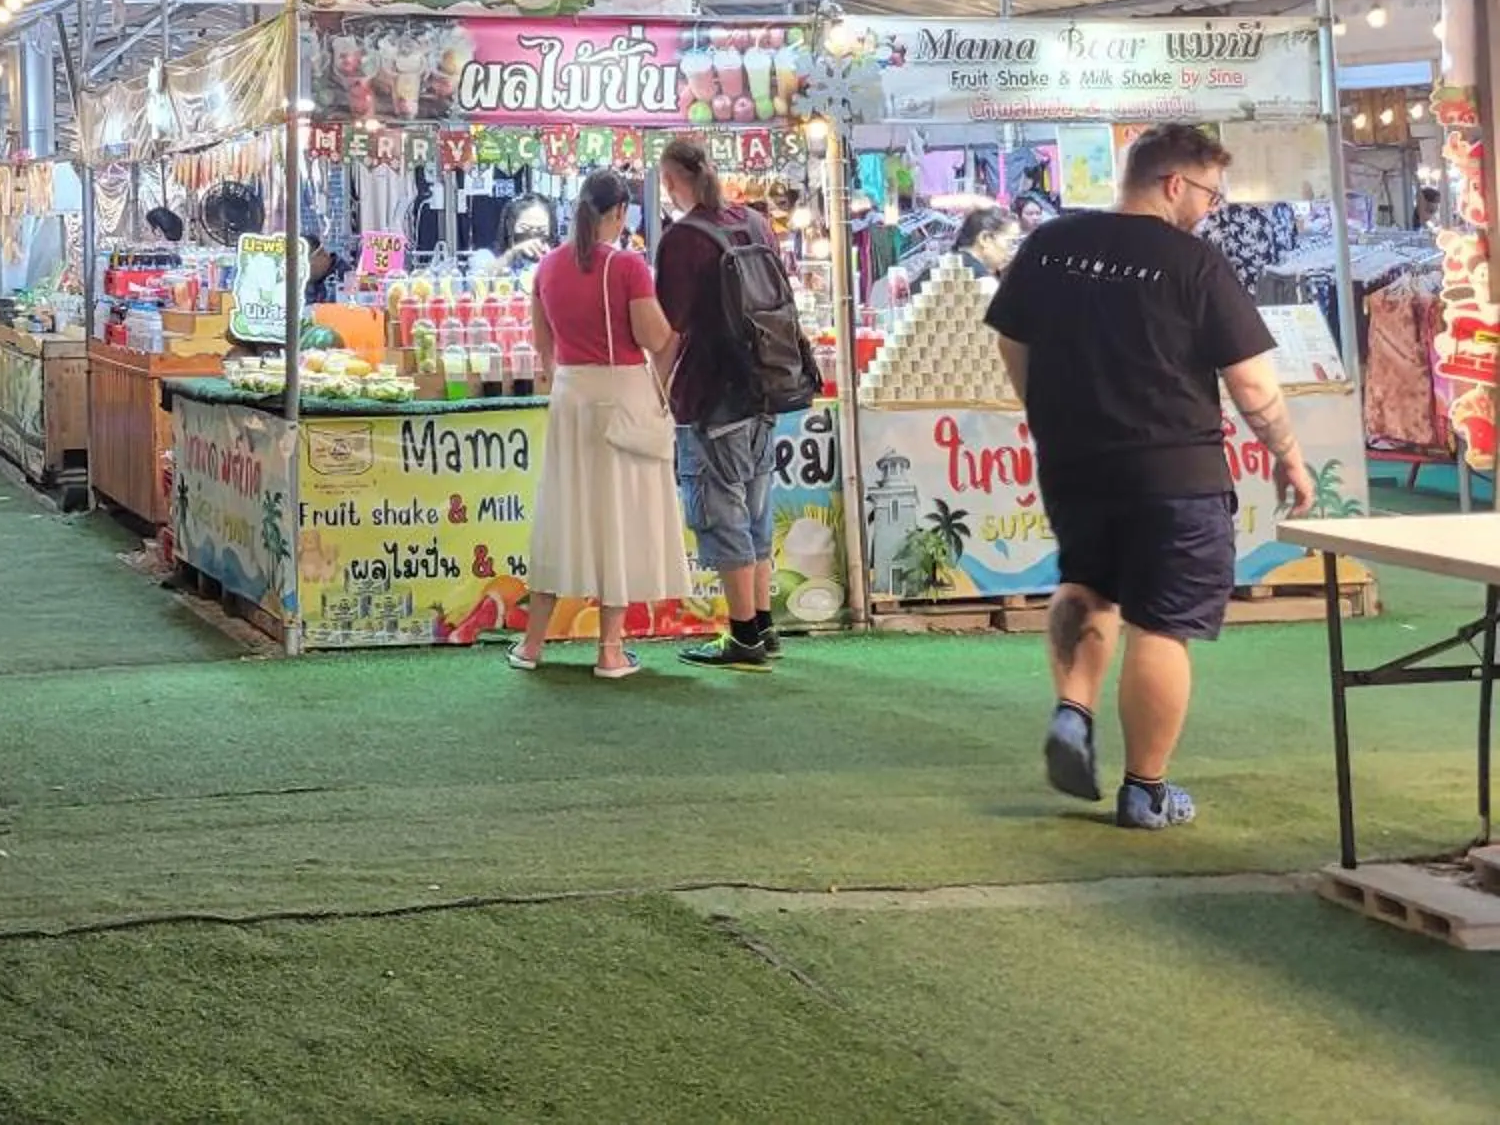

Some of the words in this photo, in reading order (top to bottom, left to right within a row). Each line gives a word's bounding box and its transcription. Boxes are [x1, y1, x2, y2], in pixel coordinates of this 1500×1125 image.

[916, 27, 1038, 62] Mama
[1165, 22, 1264, 61] แม่หมี
[459, 25, 680, 113] ผลไม้ปั่น
[951, 69, 989, 87] Fruit
[998, 69, 1049, 87] Shake
[1080, 69, 1113, 86] Milk
[1122, 68, 1172, 86] Shake
[1180, 67, 1200, 89] by
[314, 127, 466, 163] MERRY
[401, 419, 530, 475] Mama
[299, 501, 361, 526] Fruit
[371, 497, 439, 526] shake
[447, 493, 468, 524] &
[476, 494, 526, 523] Milk
[978, 512, 1054, 542] SUPE
[351, 536, 461, 581] ผลไม้ปั่น
[472, 543, 497, 579] &
